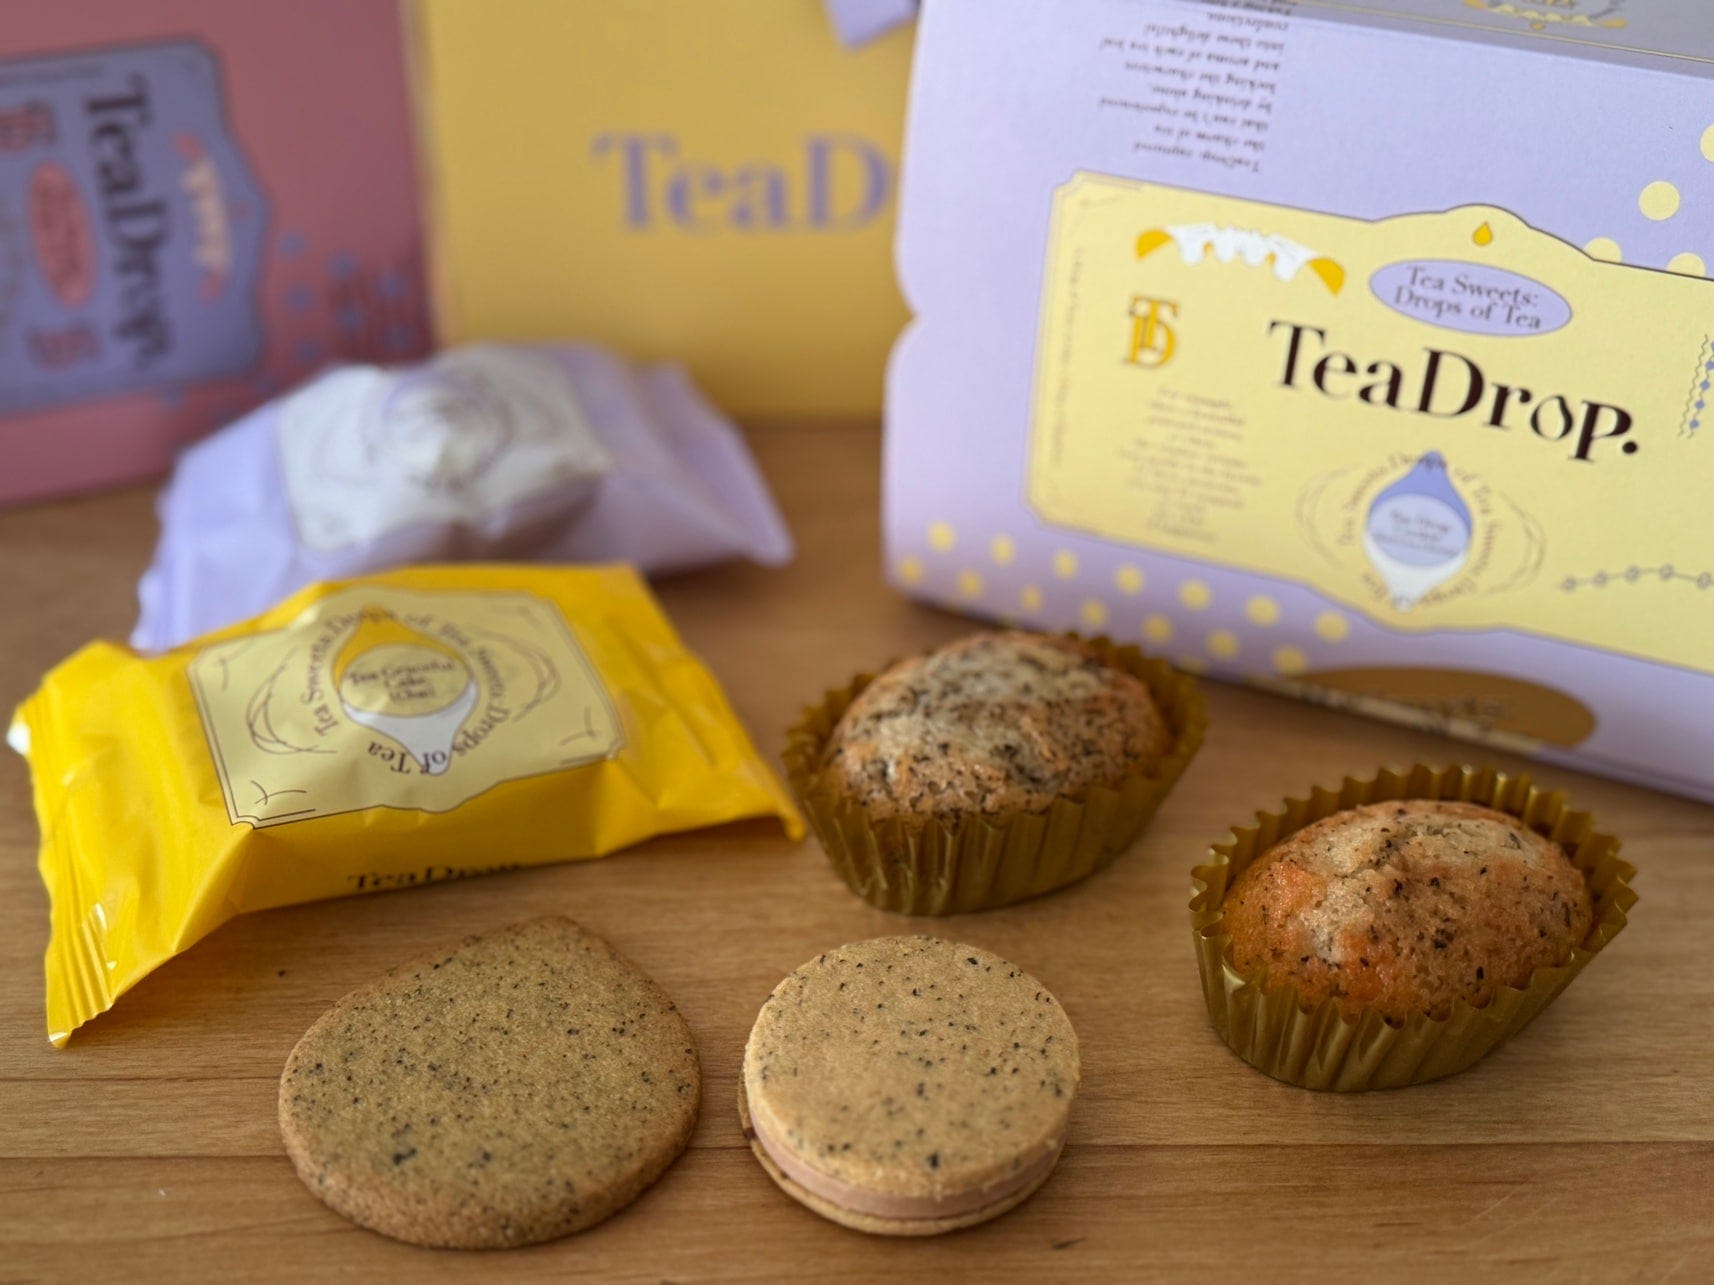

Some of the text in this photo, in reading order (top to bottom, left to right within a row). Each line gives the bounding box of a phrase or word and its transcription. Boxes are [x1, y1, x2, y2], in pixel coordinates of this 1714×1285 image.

[1394, 285, 1542, 330] Drops of Tea
[1407, 264, 1539, 308] Tea Sweets:
[1265, 320, 1639, 463] TeaDrop.
[313, 703, 339, 737] Tea
[452, 704, 510, 757] Drops
[367, 741, 411, 775] Tea
[420, 751, 447, 775] of
